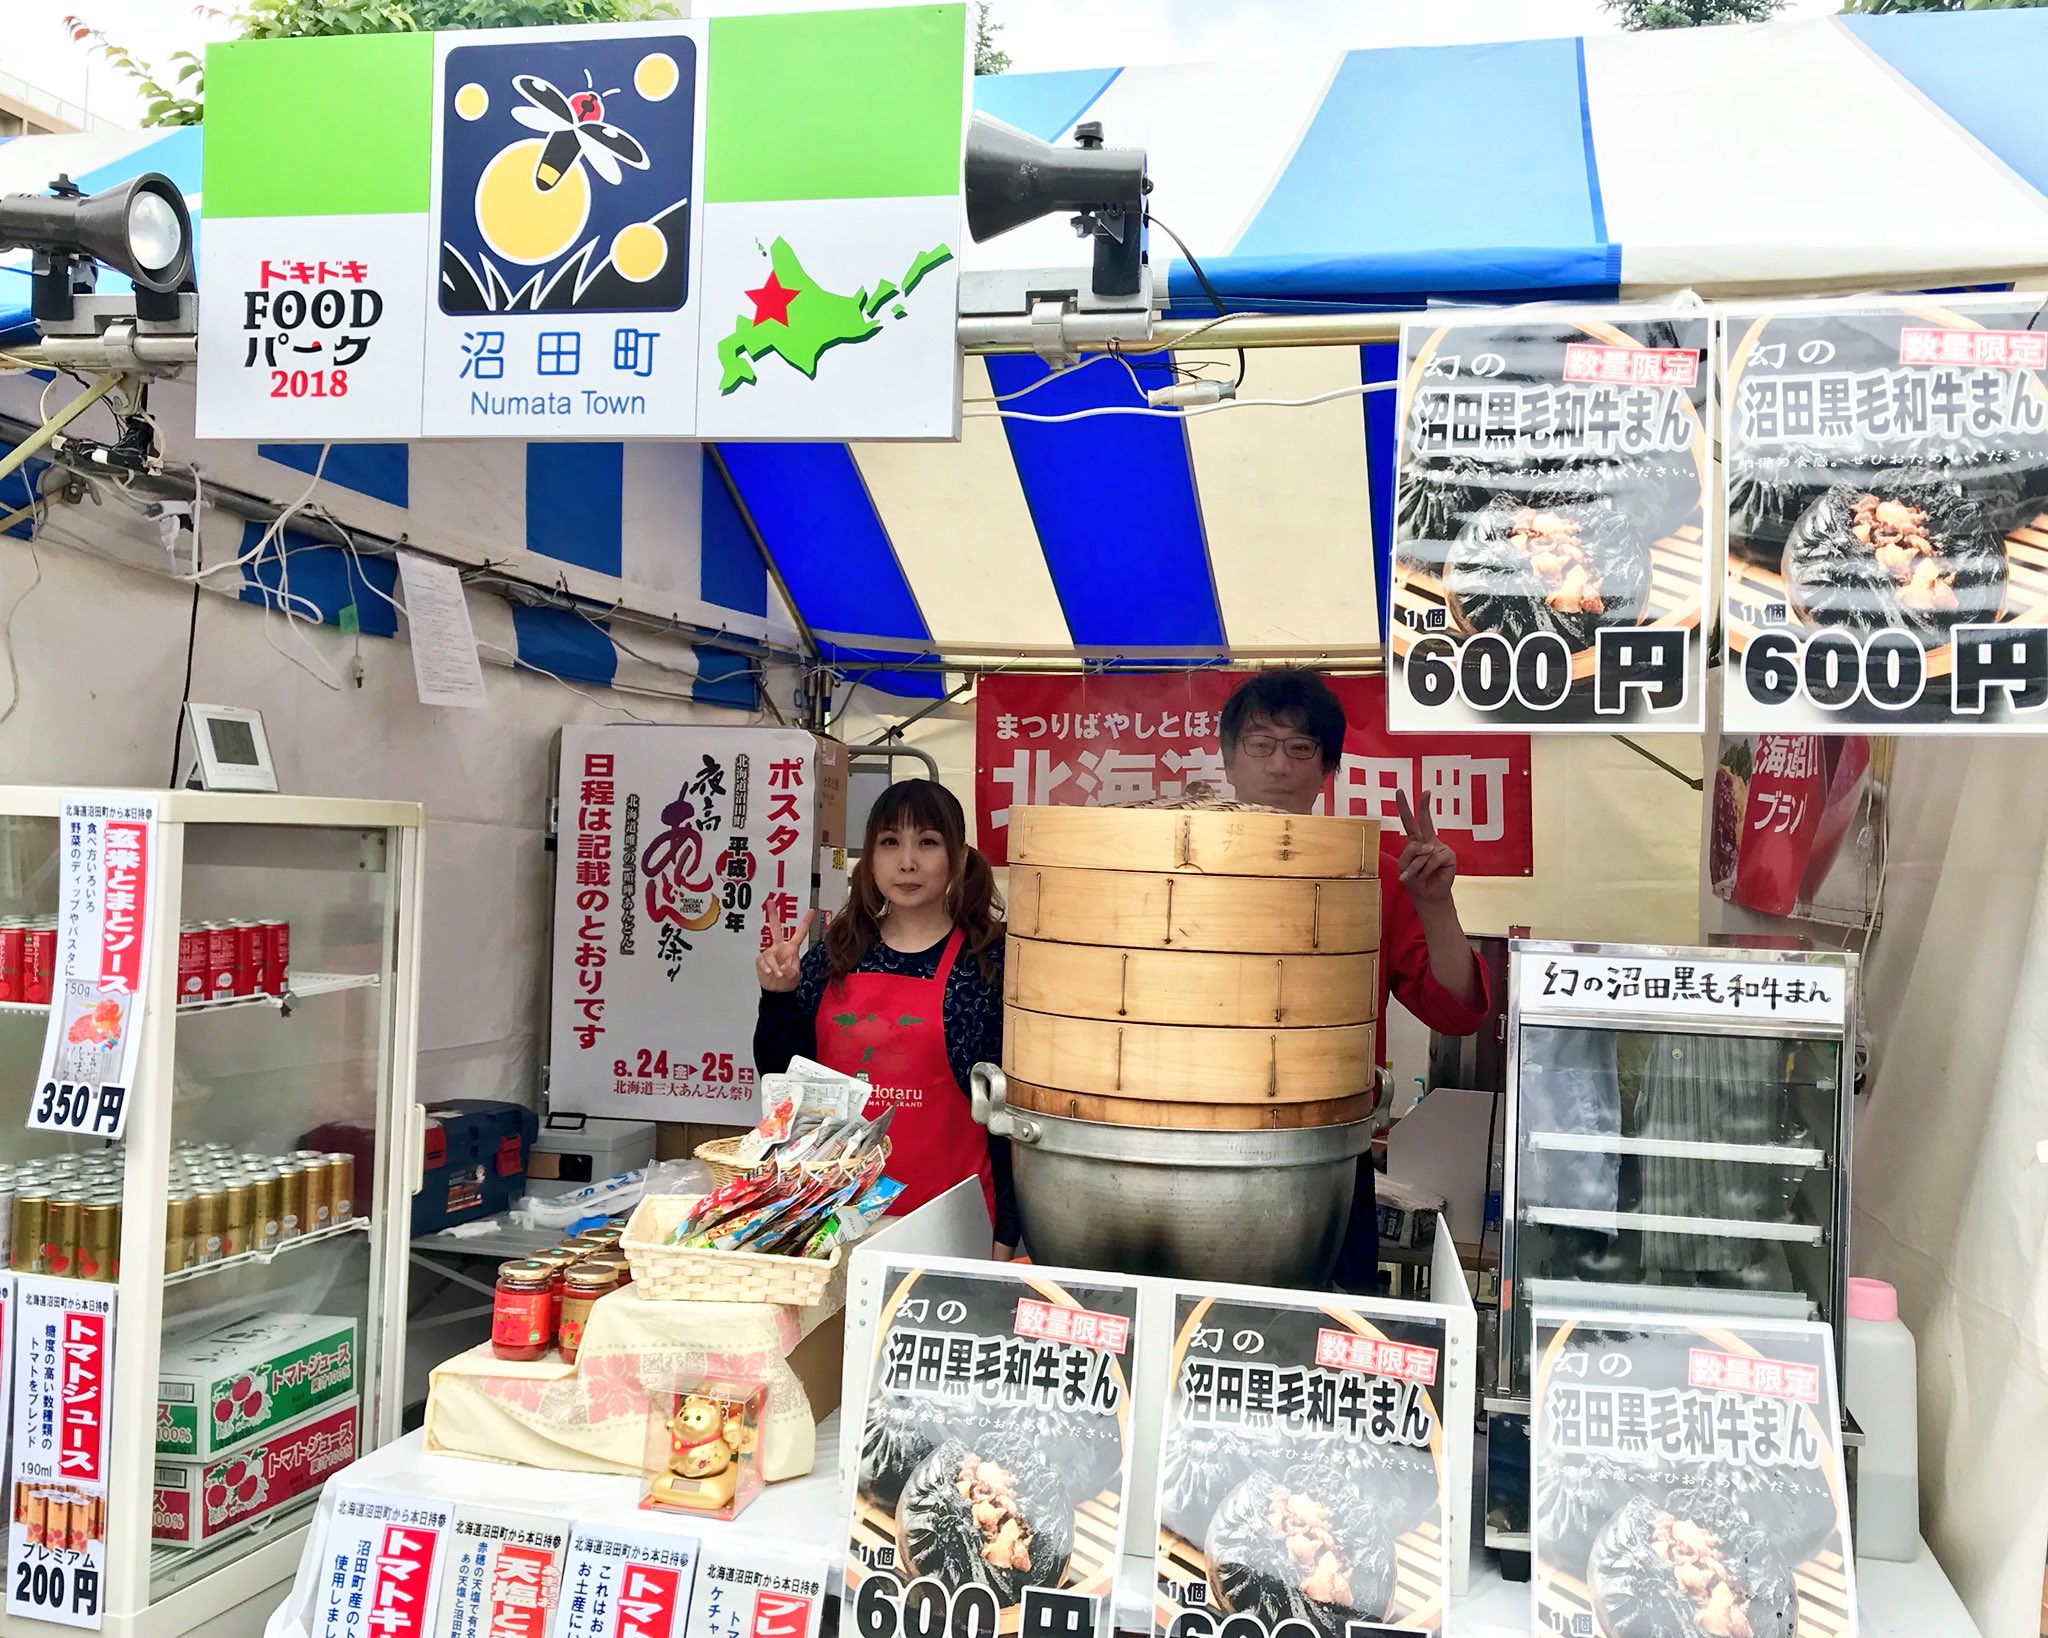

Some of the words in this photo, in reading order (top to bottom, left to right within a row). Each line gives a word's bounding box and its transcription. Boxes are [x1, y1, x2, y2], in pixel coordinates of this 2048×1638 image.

[260, 260, 368, 289] ドキドキ
[243, 289, 384, 330] FOOD
[243, 332, 372, 368] パーク
[458, 328, 661, 379] 沼田町
[1423, 351, 1507, 380] 幻の
[1569, 349, 1694, 382] 数量限定
[1746, 340, 1837, 369] 幻の
[1905, 331, 2044, 364] 数量限定
[270, 369, 349, 398] 2018
[470, 391, 572, 415] Numata
[580, 390, 646, 415] Town
[1745, 370, 2045, 440] 沼田黒毛和牛まん
[1414, 386, 1692, 451] 沼田黒毛和牛まん
[732, 753, 750, 829] 北海道沼田町
[85, 822, 97, 914] 食べ方いろいろ
[65, 822, 82, 977] 野菜のディップやパスタに
[98, 827, 142, 996] 玄米とまとソース
[573, 753, 615, 1050] 日程は記載のとおりです
[65, 982, 91, 996] 150g
[1542, 961, 1832, 1011] 幻の沼田黒毛和牛まん
[614, 1079, 754, 1102] 北海道三大あんどん祭り
[701, 1052, 734, 1084] 25
[37, 1082, 90, 1128] 350
[895, 1293, 968, 1325] 幻の
[1019, 1303, 1125, 1349] 数量限定
[272, 1341, 351, 1395] トマトジュース
[884, 1331, 1119, 1411] 沼田黒毛和牛まん
[1190, 1323, 1266, 1355] 幻の
[1320, 1332, 1435, 1379] 数量限定
[1553, 1346, 1633, 1378] 幻の
[1692, 1354, 1817, 1398] 数量限定
[28, 1337, 40, 1449] トマトをブレンド
[42, 1324, 57, 1451] 糖度の高い数種類の
[60, 1319, 98, 1472] トマトジュース
[1183, 1362, 1430, 1441] 沼田黒毛和牛まん
[268, 1420, 354, 1479] トマトジュース
[1551, 1387, 1819, 1462] 沼田黒毛和牛まん
[21, 1462, 52, 1478] 190ml
[338, 1500, 447, 1528] 北海道沼田町から本日持参
[455, 1520, 562, 1549] 北海道沼田町から本日持参
[22, 1543, 96, 1570] プレミアム
[574, 1536, 690, 1568] 北海道沼田町から本日持参
[15, 1561, 66, 1609] 200
[706, 1564, 820, 1596] 北海道沼田町から本日持参
